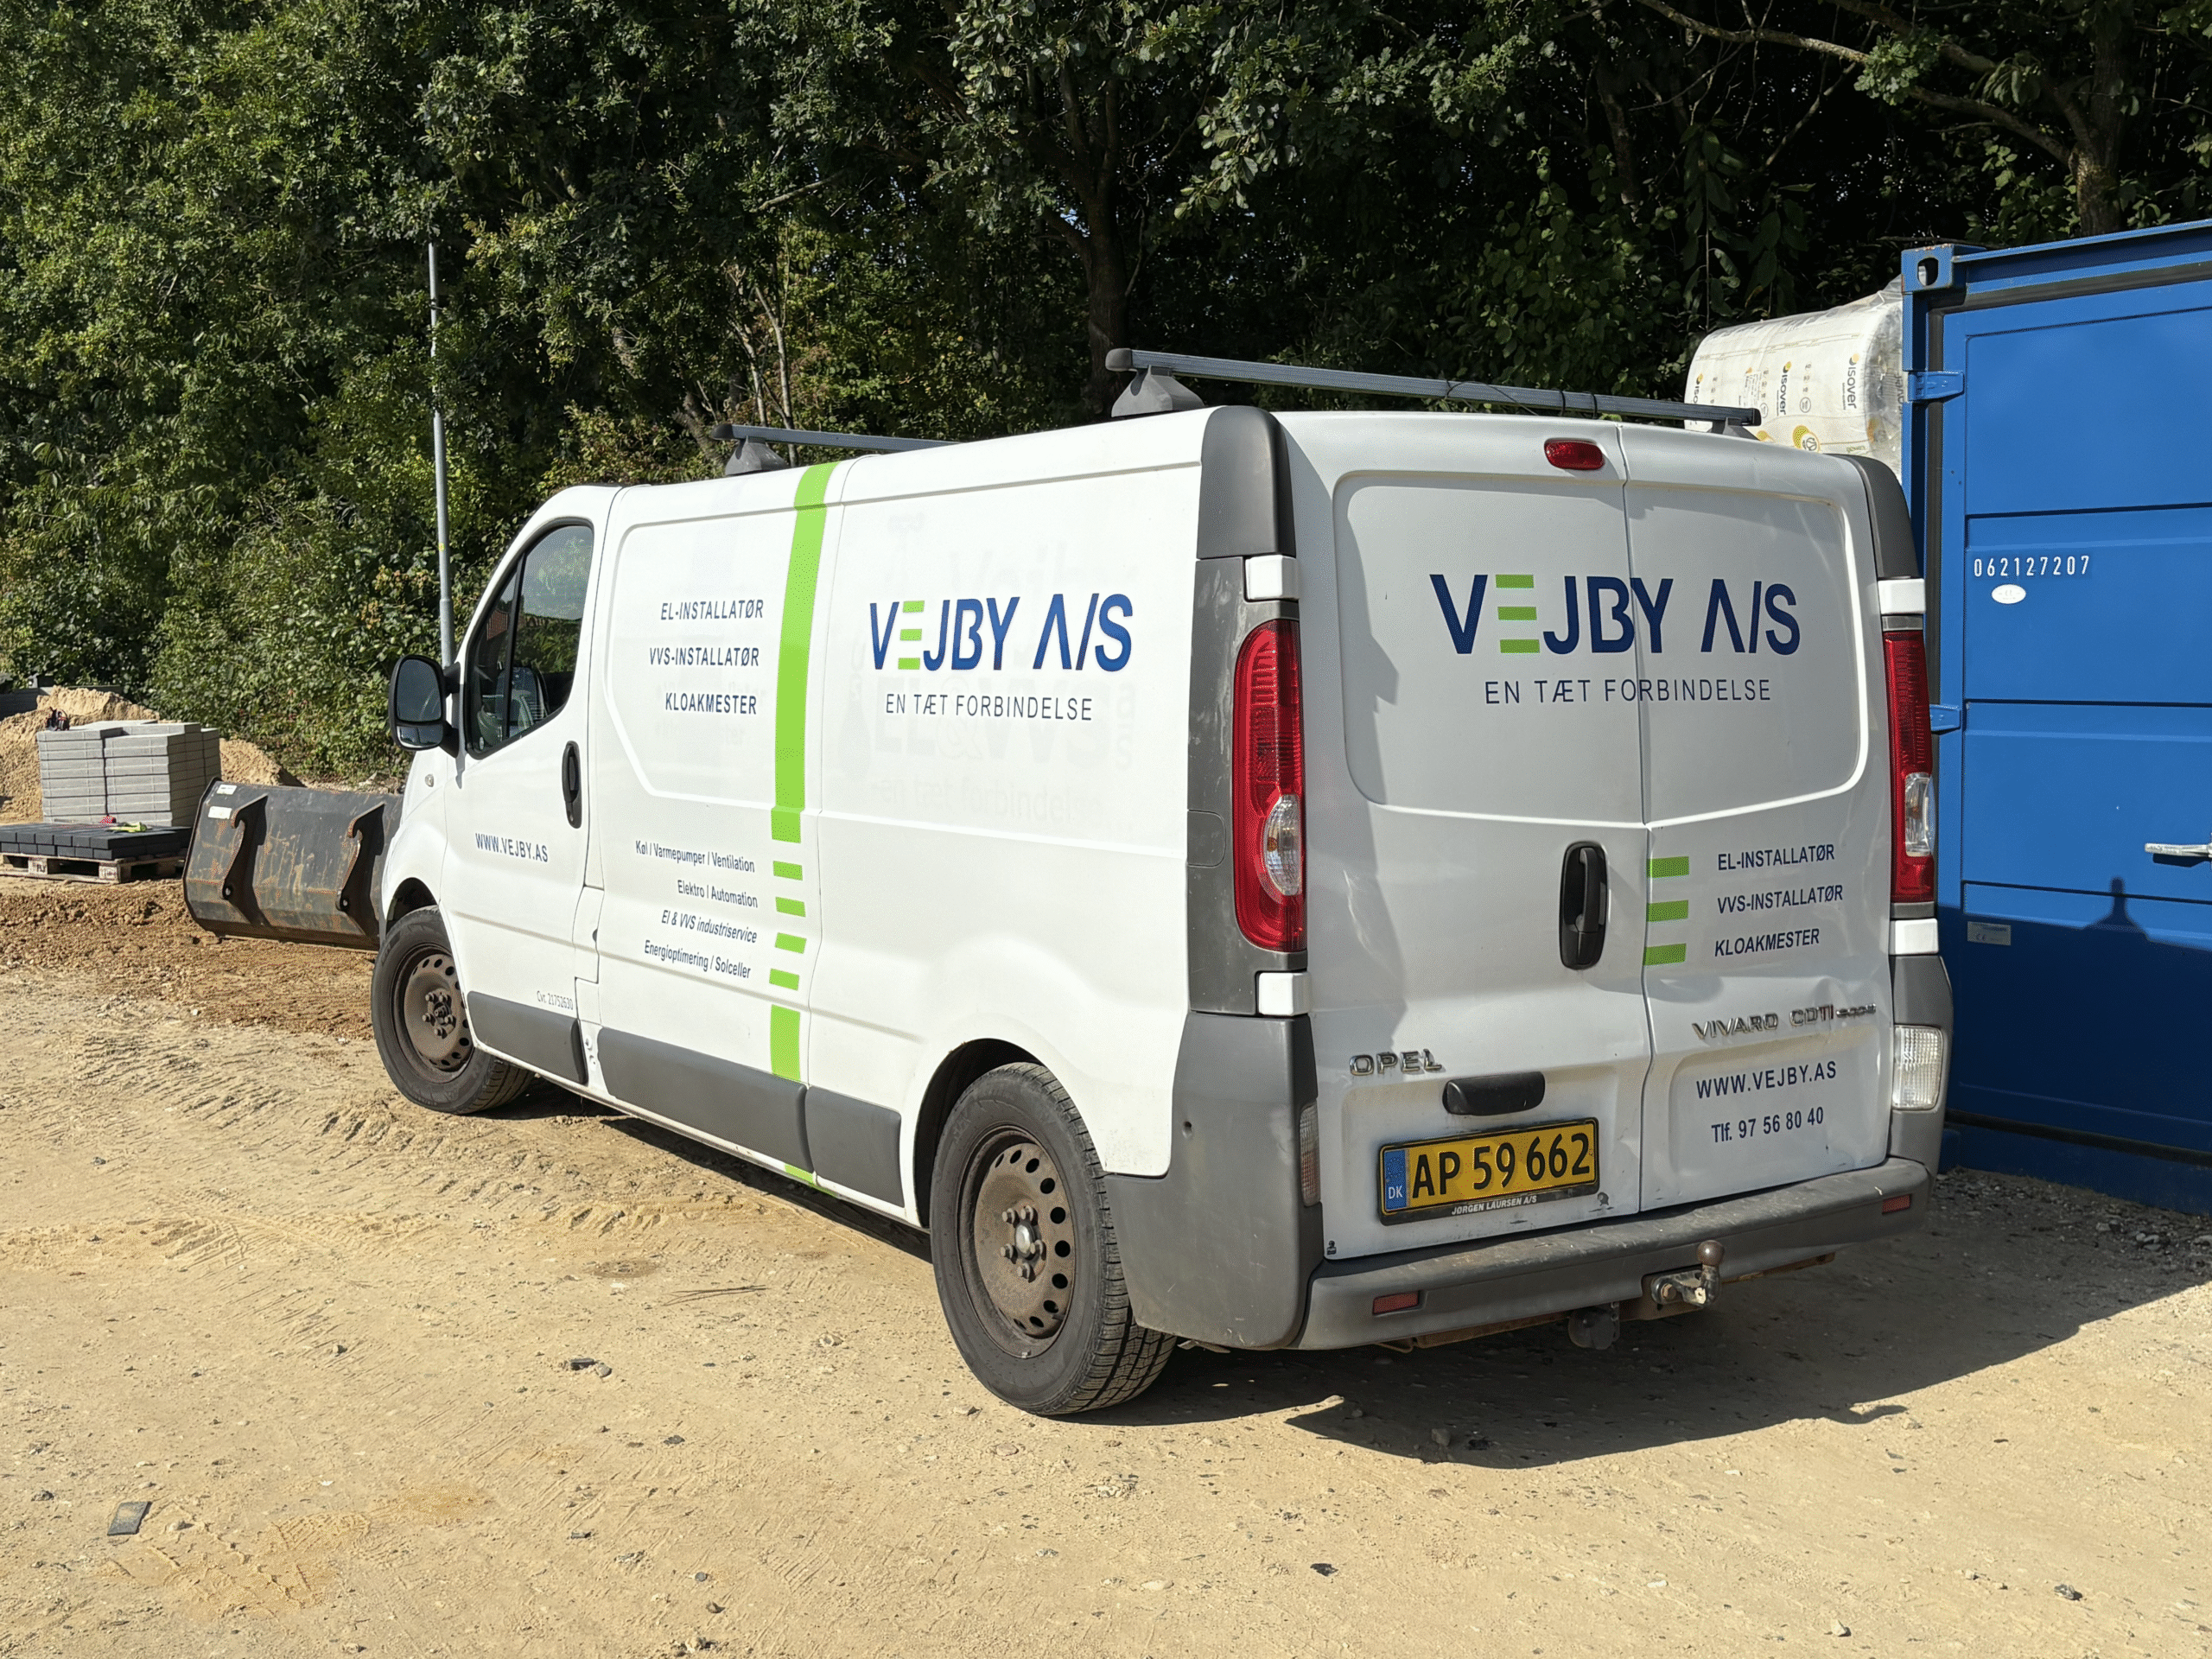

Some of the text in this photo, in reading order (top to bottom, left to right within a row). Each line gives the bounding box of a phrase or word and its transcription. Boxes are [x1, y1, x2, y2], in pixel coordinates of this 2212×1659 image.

[1847, 366, 1857, 409] isover
[1974, 555, 2089, 577] 062127207
[660, 599, 764, 620] EL-INSTALLATØR
[1429, 574, 1801, 656] VEJBY A/S
[869, 593, 1133, 672] VEJBY A/S
[649, 646, 760, 667] VVS-INSTALLATØR
[665, 692, 757, 715] KLOAKMESTER
[1485, 678, 1770, 704] EN TÆT FORBINDELSE
[886, 693, 1092, 721] EN TÆT FORBINDELSE
[474, 833, 548, 862] WWW.VEJBY.AS
[635, 840, 648, 855] Køl
[653, 842, 705, 866] Varmepumper
[711, 851, 755, 873] Ventilation
[1718, 843, 1834, 871] EL-INSTALLATØR
[677, 879, 705, 898] Elektro
[711, 886, 758, 908] Automation
[1718, 885, 1843, 914] VVS-INSTALLATØR
[661, 910, 758, 944] El & VVS industriservice
[1714, 928, 1820, 957] KLOAKMESTER
[644, 939, 709, 972] Energioptimering
[715, 957, 751, 978] Solceller
[1692, 1013, 1779, 1040] VIVARO
[1789, 1004, 1834, 1027] CDTI
[1350, 1049, 1442, 1076] OPEL
[1696, 1060, 1836, 1099] WWW.VEJBY.AS
[1711, 1106, 1823, 1143] Tlf. 97 56 80 40
[1412, 1132, 1590, 1198] AP 59 662
[1389, 1185, 1403, 1199] DK
[1485, 1197, 1522, 1211] LAURSEN
[1523, 1195, 1537, 1205] A/S
